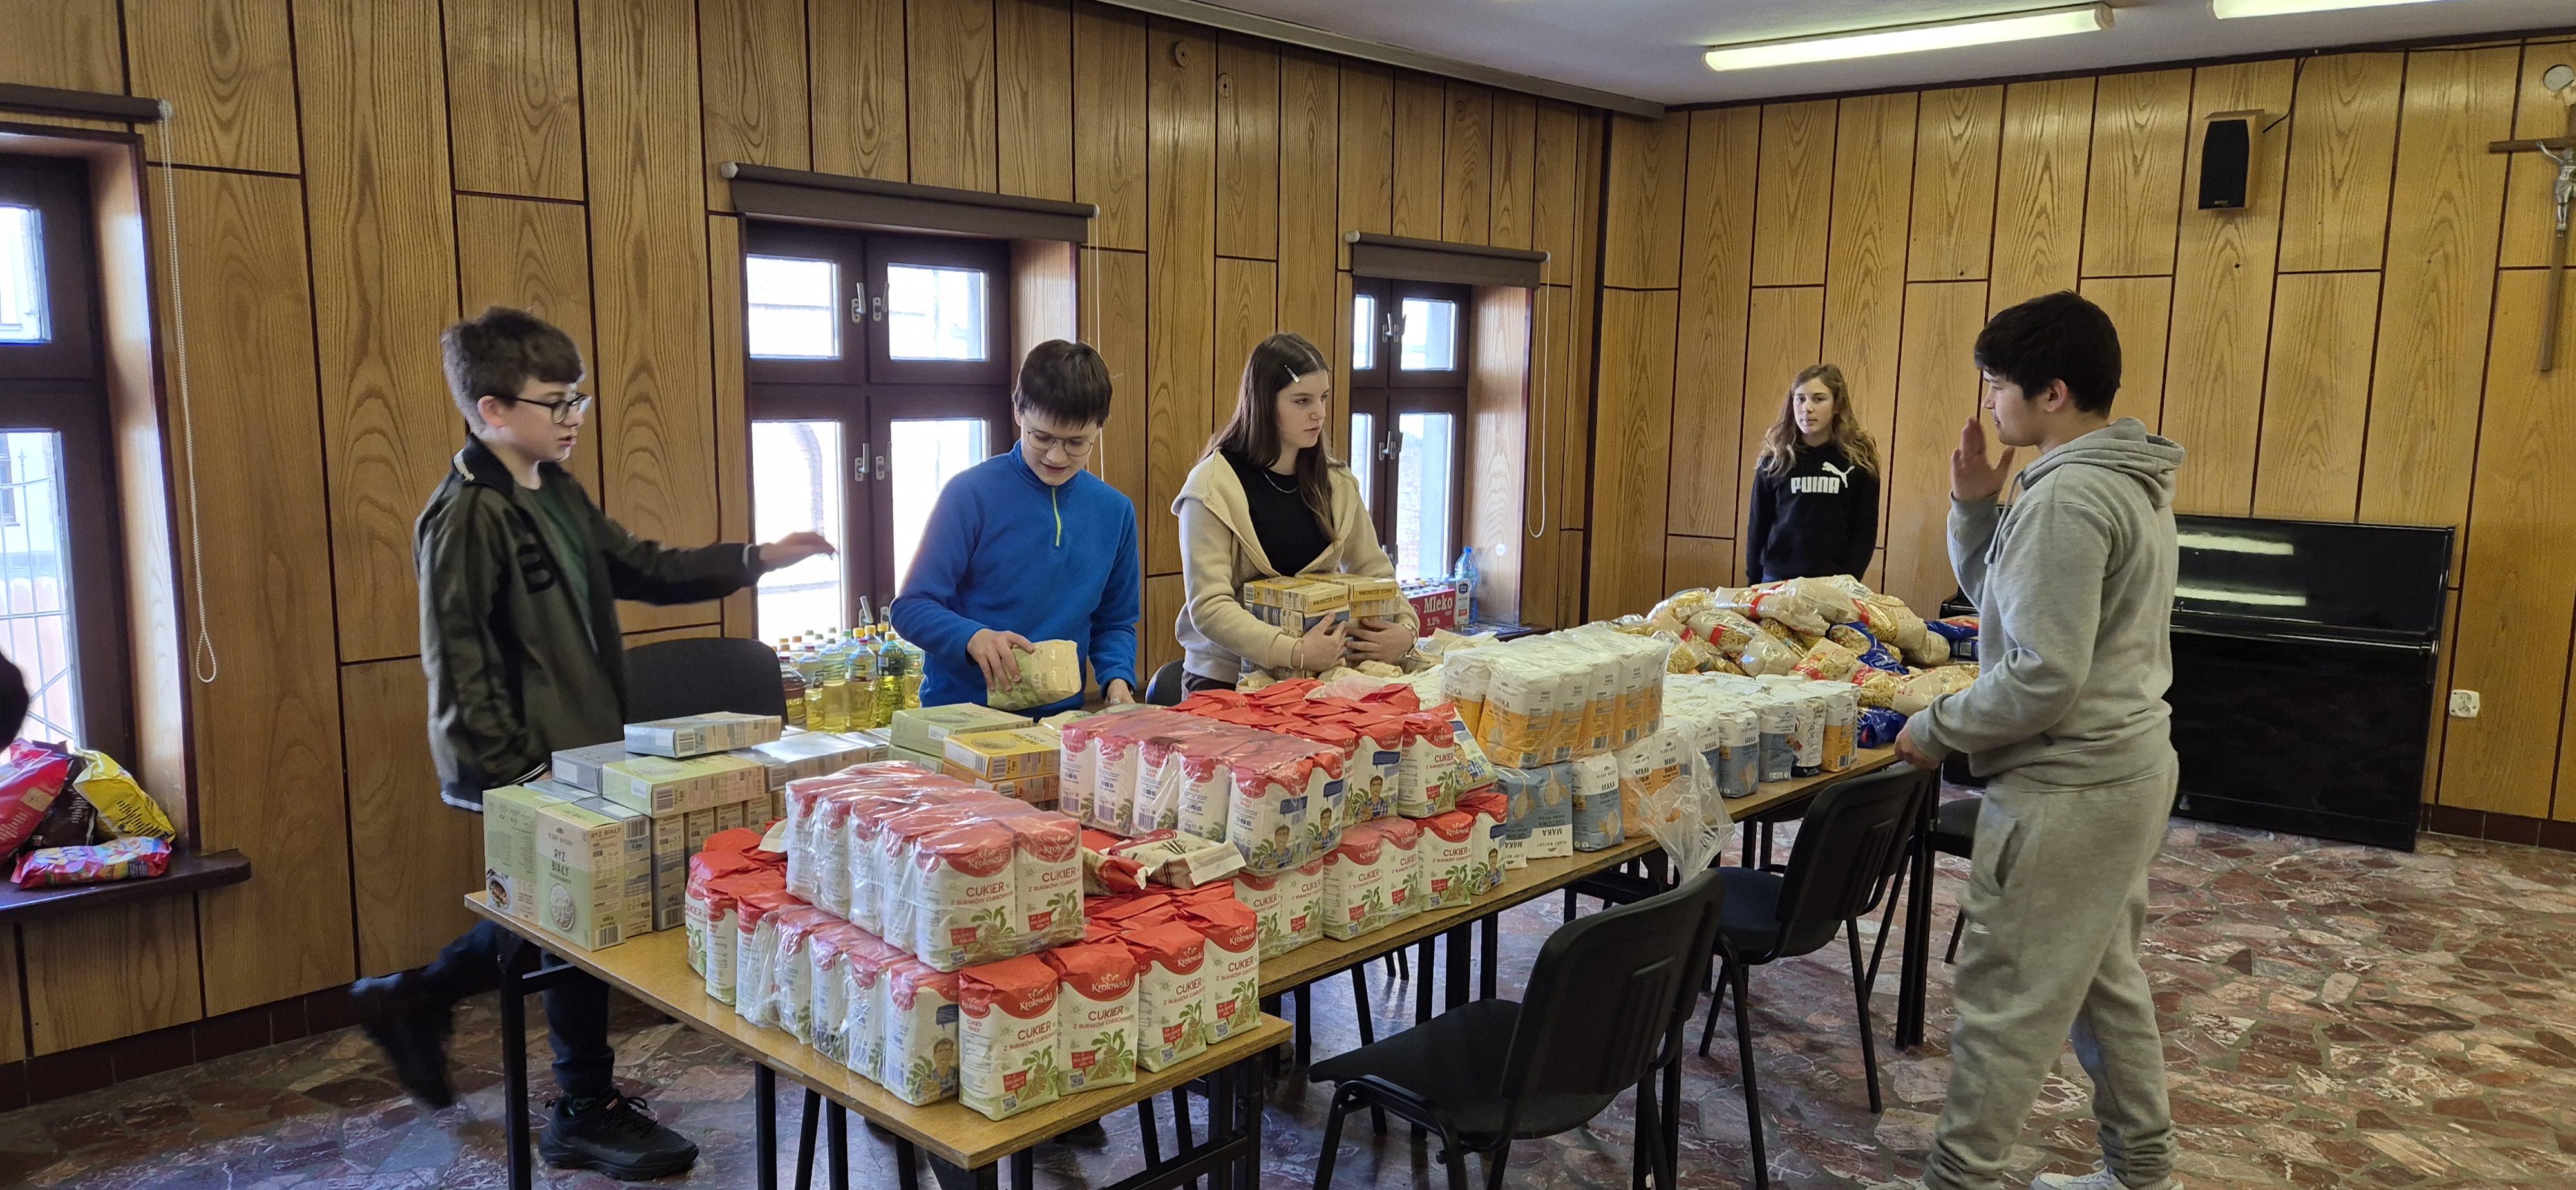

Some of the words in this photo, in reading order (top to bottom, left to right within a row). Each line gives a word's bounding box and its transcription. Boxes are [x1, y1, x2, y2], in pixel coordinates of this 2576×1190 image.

[1790, 476, 1841, 494] PUMA
[1423, 594, 1454, 614] Mleko
[1426, 616, 1441, 627] 3,2%
[1542, 827, 1562, 836] MĄKA
[1443, 846, 1468, 857] CUKIER
[551, 861, 569, 876] BIAŁY
[1041, 866, 1077, 883] CUKIER
[1358, 867, 1379, 882] CUKIER
[965, 881, 1005, 898] CUKIER
[956, 896, 985, 905] BURAKÓW
[1253, 893, 1278, 908] CUKIER
[1227, 956, 1254, 973] CUKIER
[1175, 977, 1202, 996] CUKIER
[1088, 1005, 1124, 1022] CUKIER
[967, 1019, 982, 1028] CUKIER
[1017, 1021, 1052, 1041] CUKIER
